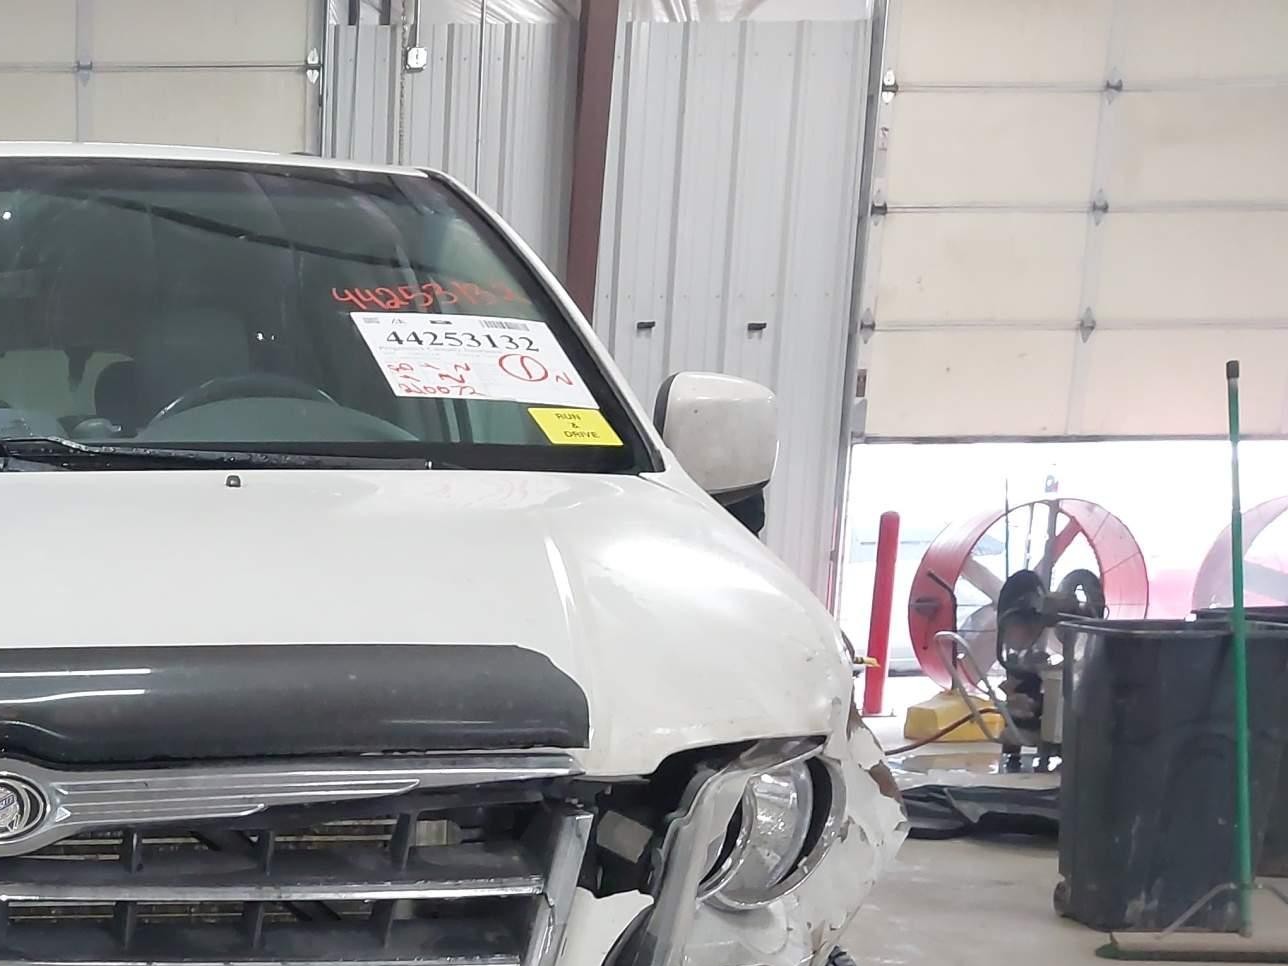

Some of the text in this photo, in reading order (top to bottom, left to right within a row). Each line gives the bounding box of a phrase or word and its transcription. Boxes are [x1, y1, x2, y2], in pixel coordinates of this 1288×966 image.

[386, 331, 540, 352] 44253132
[555, 412, 582, 421] RUN
[563, 430, 600, 439] DRIVE
